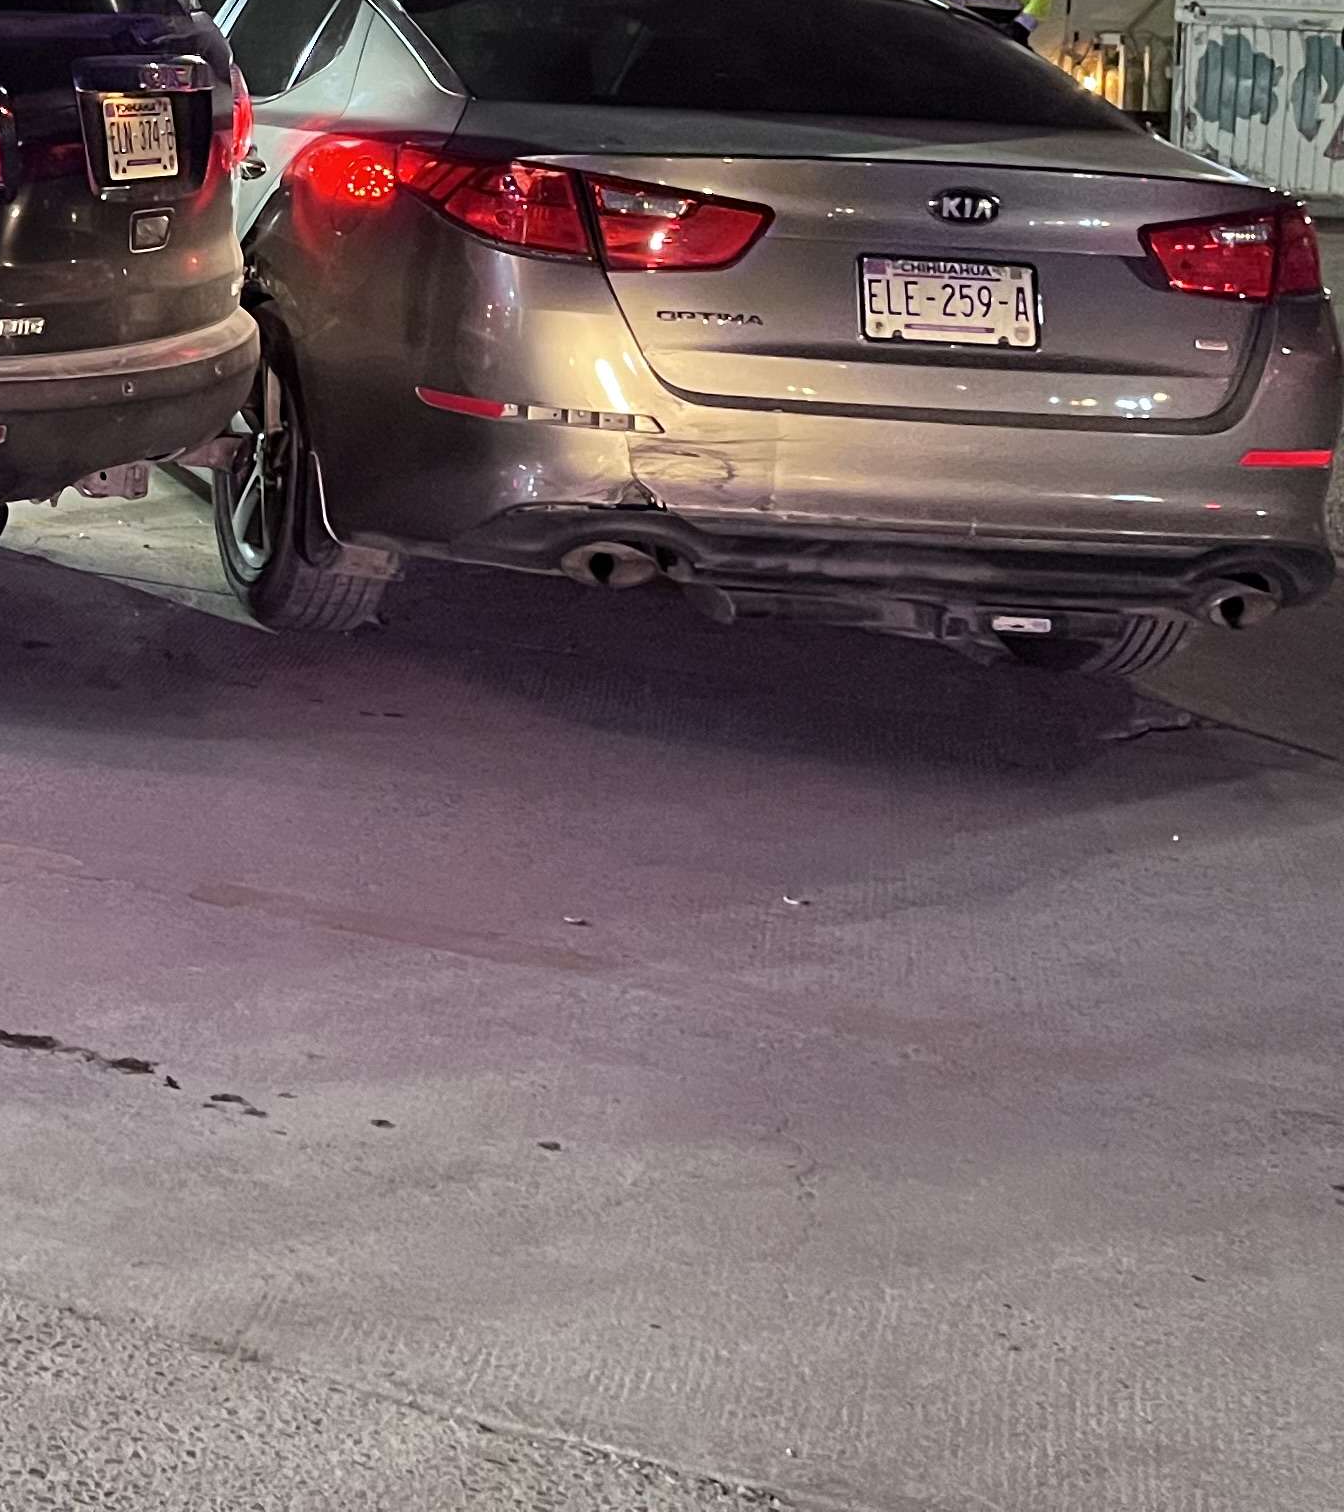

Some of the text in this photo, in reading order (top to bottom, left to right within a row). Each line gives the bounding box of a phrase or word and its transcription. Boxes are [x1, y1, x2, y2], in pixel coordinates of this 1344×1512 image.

[941, 195, 993, 219] KIA
[901, 262, 992, 277] CHIHUAHUA
[867, 278, 1030, 323] ELE-259-A
